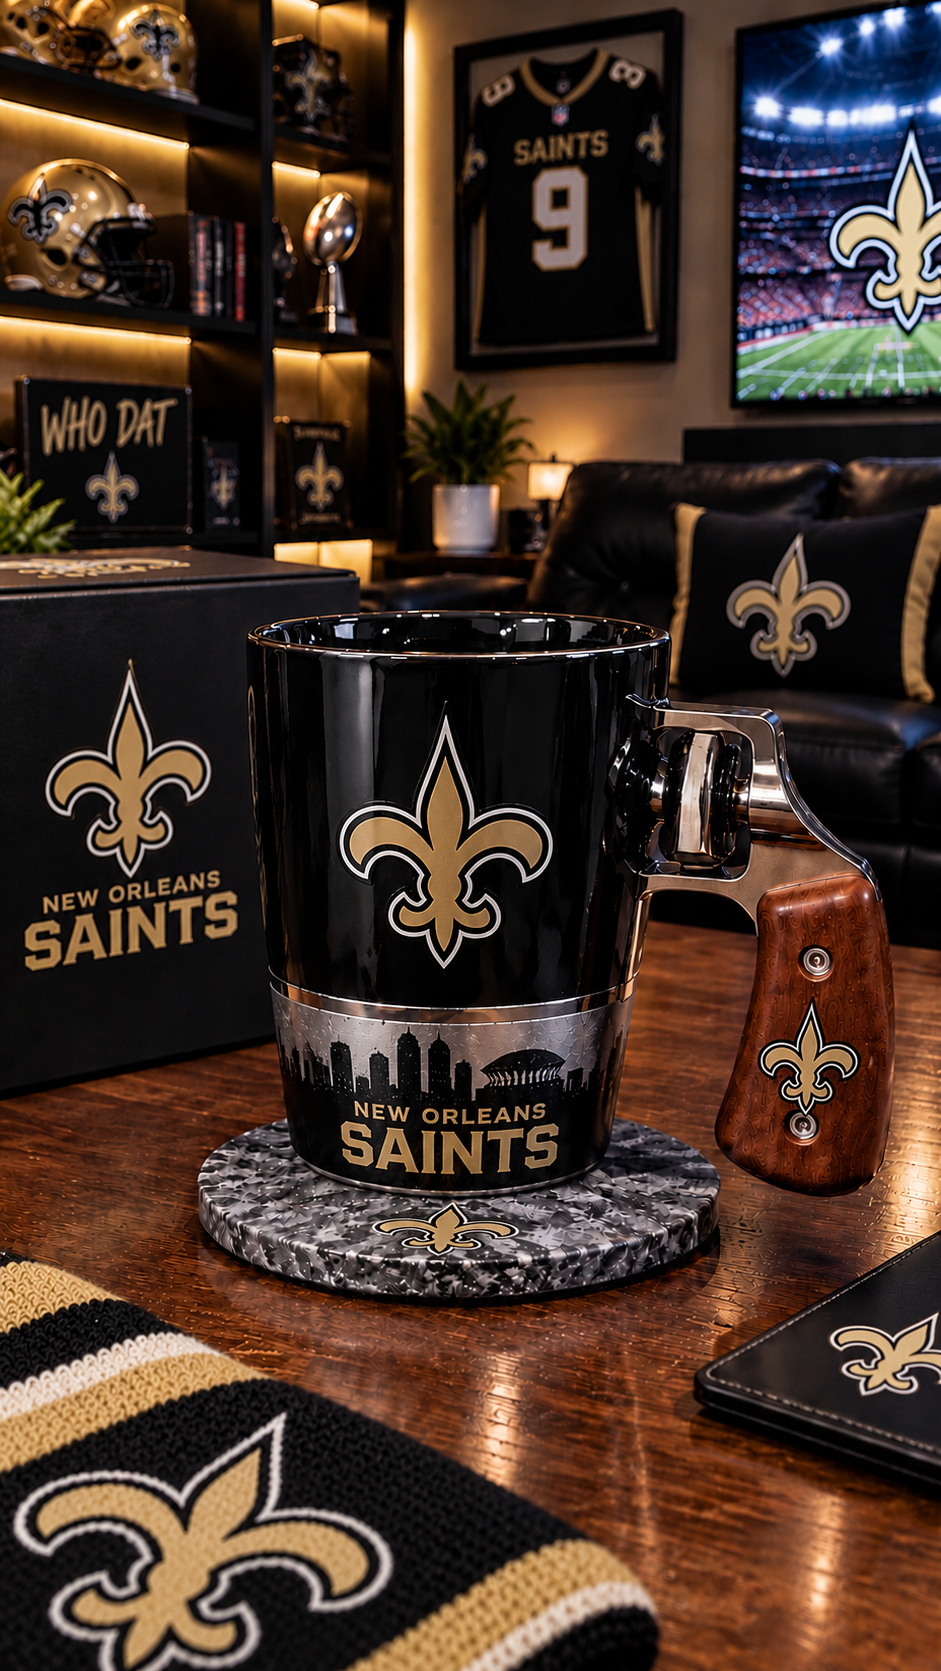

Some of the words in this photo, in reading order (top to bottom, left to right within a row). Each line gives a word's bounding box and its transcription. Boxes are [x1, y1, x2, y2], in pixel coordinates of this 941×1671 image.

[513, 129, 609, 166] SAINTS
[531, 165, 589, 272] 9
[41, 396, 107, 456] WHO
[116, 398, 179, 448] DAT
[43, 888, 99, 914] NEW
[108, 870, 221, 904] ORLEANS
[24, 890, 238, 972] SAINTS
[354, 1100, 410, 1122] NEW
[422, 1103, 546, 1125] ORLEANS
[340, 1120, 559, 1175] SAINTS
